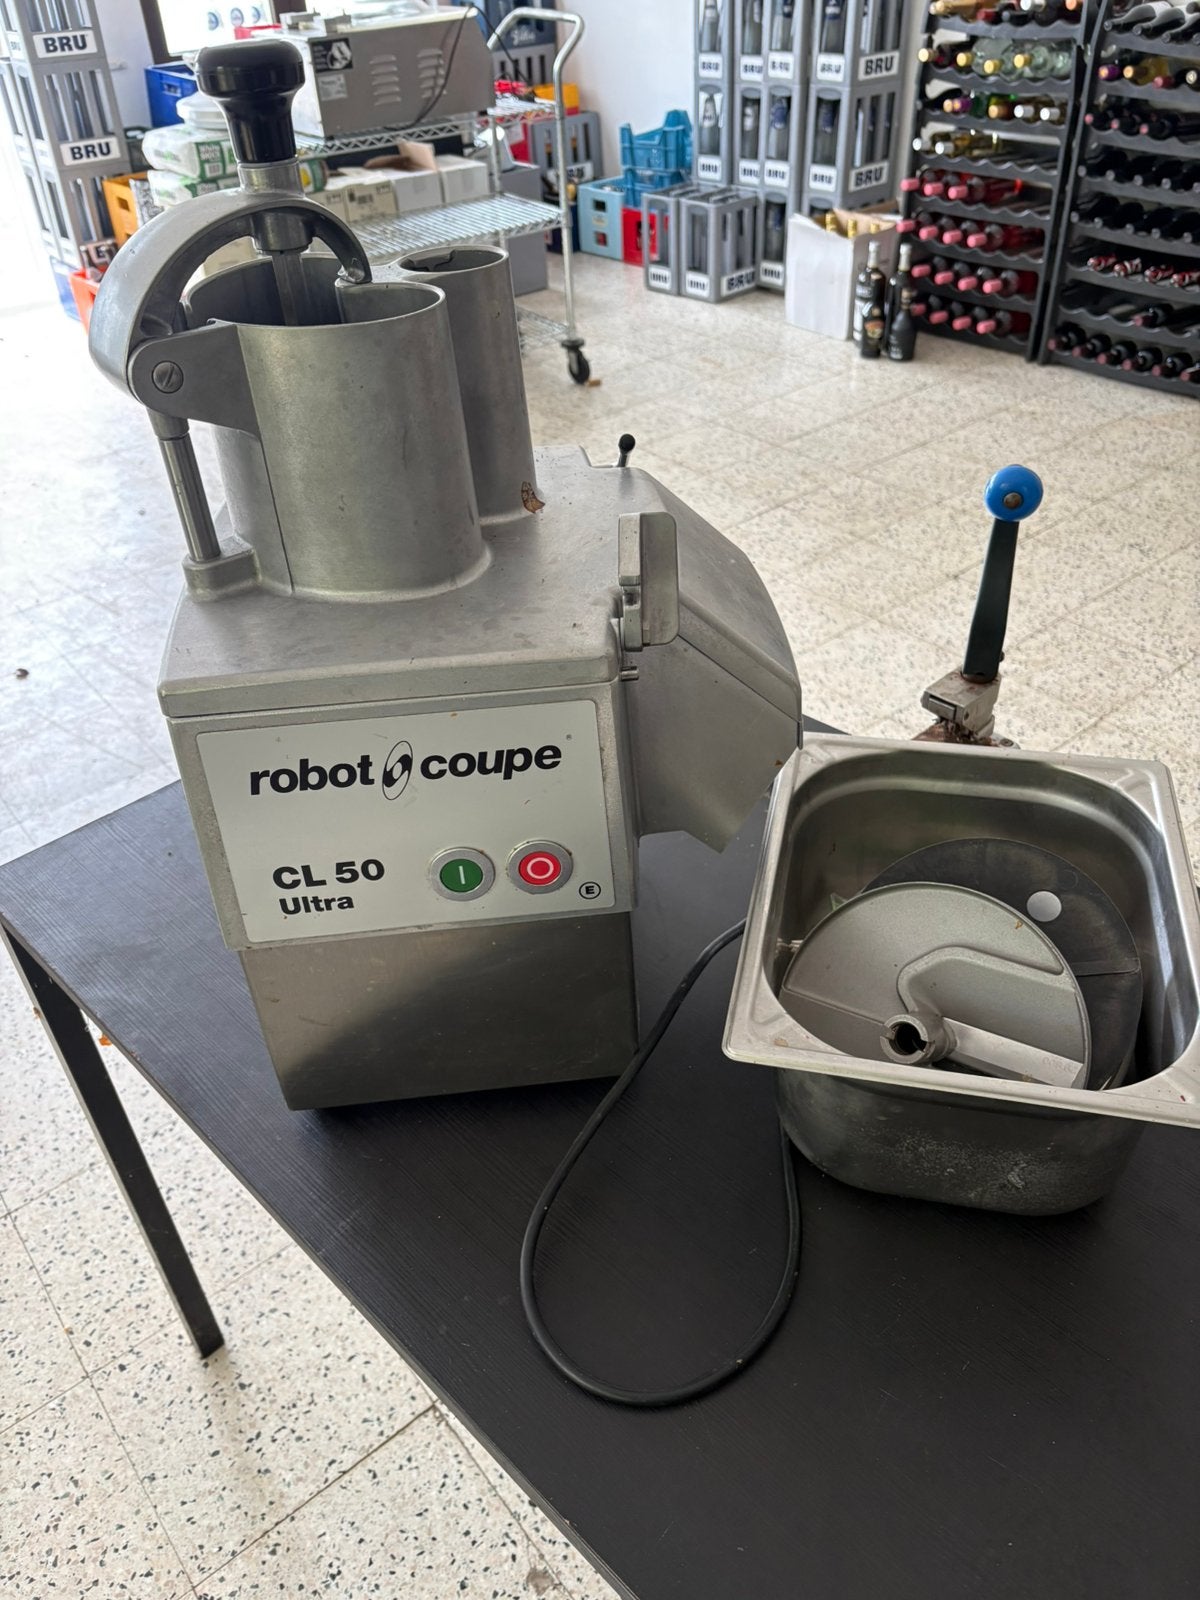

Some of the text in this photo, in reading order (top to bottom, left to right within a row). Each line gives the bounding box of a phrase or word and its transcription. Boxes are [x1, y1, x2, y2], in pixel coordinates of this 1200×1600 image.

[43, 34, 88, 54] BRU
[864, 56, 895, 76] BRU
[70, 141, 111, 161] BRU
[854, 167, 884, 187] BRU
[727, 271, 756, 291] BRU
[248, 743, 562, 796] robot coupe
[272, 858, 385, 891] CL 50
[279, 893, 355, 916] Ultra
